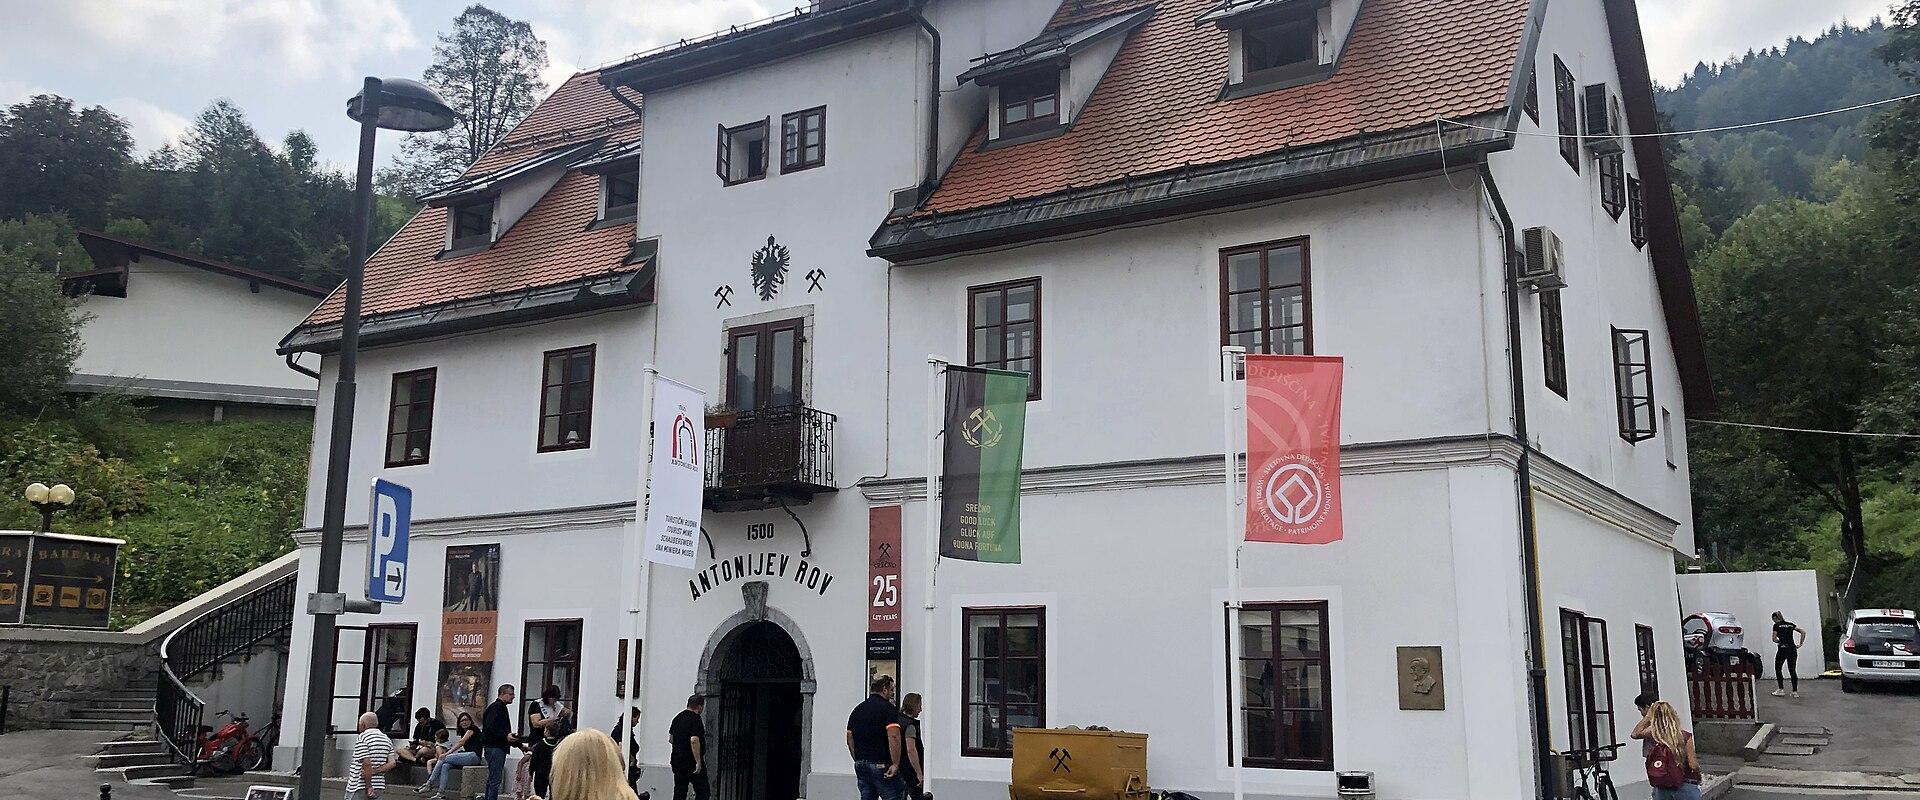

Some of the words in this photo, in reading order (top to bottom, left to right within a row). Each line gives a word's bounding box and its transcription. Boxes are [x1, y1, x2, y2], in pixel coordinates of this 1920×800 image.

[961, 515, 977, 525] GOOD
[978, 517, 996, 527] LUCK
[1259, 506, 1284, 532] HERITAGE
[1288, 515, 1326, 535] PATRIMOINE
[373, 493, 397, 578] P
[747, 522, 775, 541] 1500
[982, 530, 995, 539] AUF
[974, 542, 1003, 552] FORTUNA
[39, 549, 110, 566] BARBARA
[688, 553, 790, 602] ANTONIJEV
[794, 559, 834, 596] ROV
[873, 575, 898, 607] 25
[453, 634, 483, 646] 500.000
